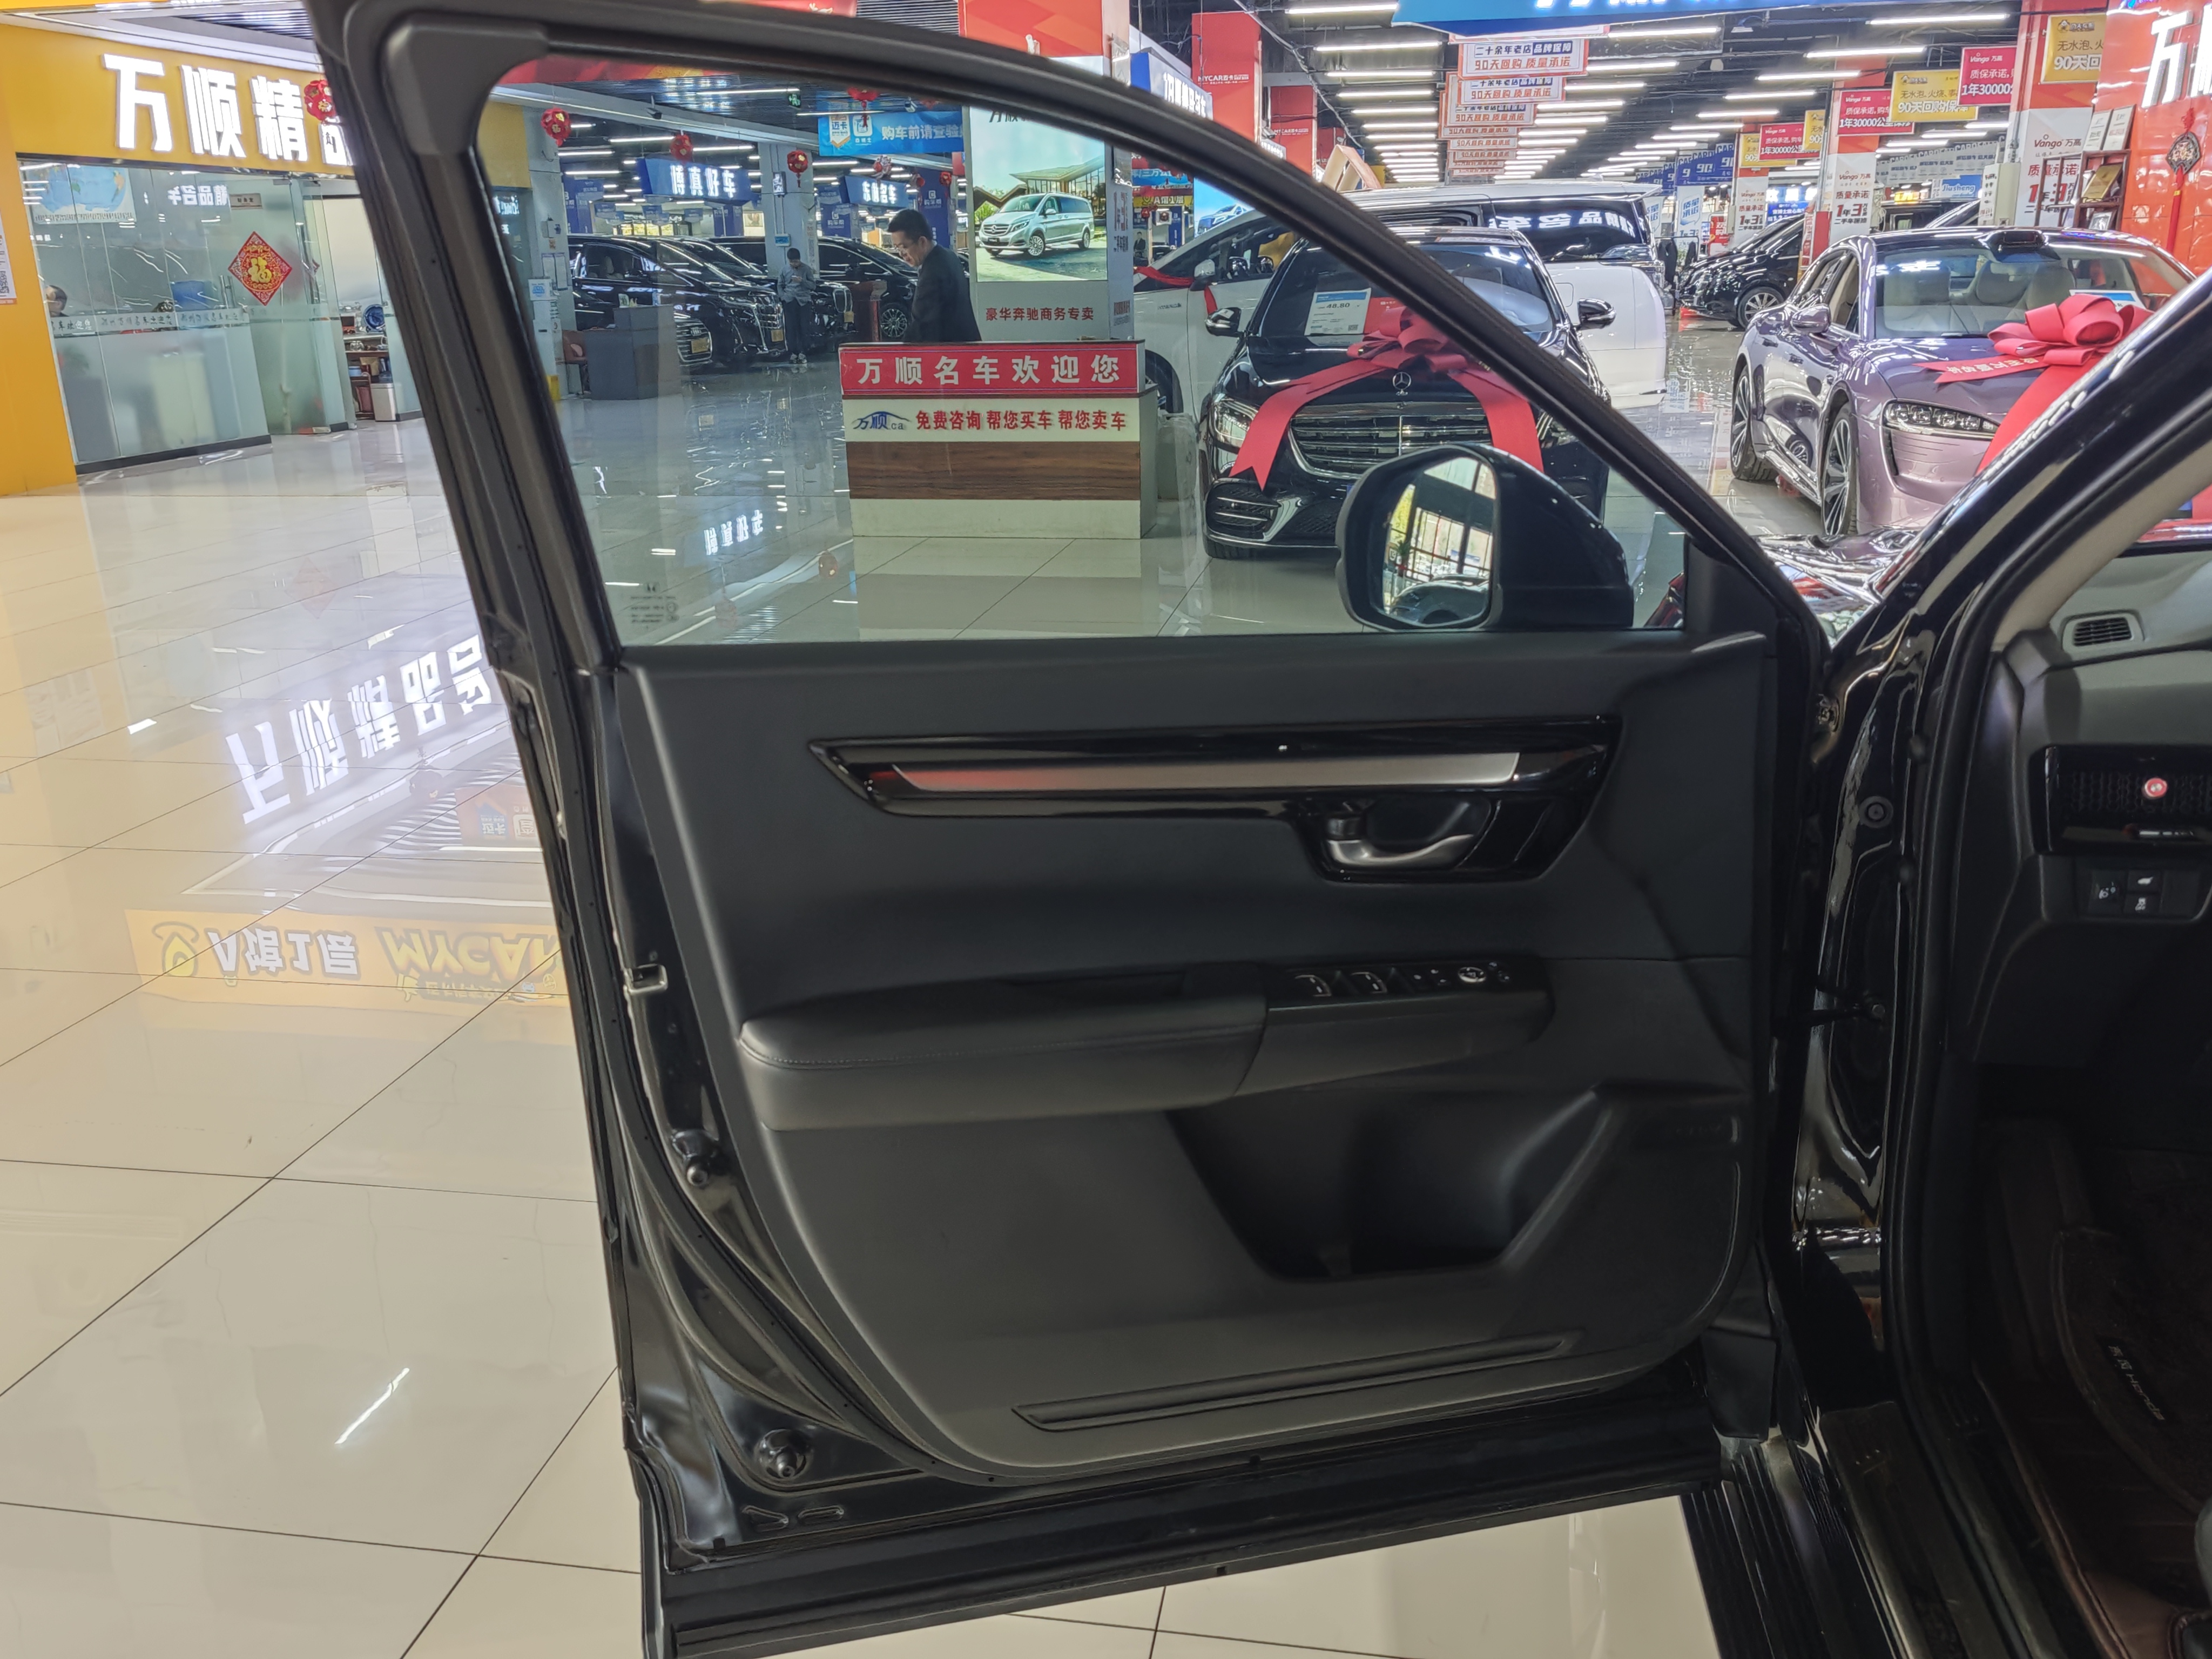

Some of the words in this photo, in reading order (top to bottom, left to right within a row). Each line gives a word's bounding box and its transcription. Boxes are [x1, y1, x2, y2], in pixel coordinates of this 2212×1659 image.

[1475, 58, 1521, 71] 90天回购
[1526, 56, 1570, 68] 质量承诺
[882, 124, 963, 141] 购车前请查验
[2034, 139, 2062, 150] Vango
[1942, 184, 1975, 192] Jiusheng
[248, 257, 272, 284] 福
[985, 306, 1094, 321] 豪华奔驰商务专卖
[856, 354, 1121, 386] 万顺名车欢迎您
[915, 409, 982, 430] 免费咨询
[987, 409, 1052, 430] 帮您买车
[1057, 409, 1127, 431] 帮您卖车
